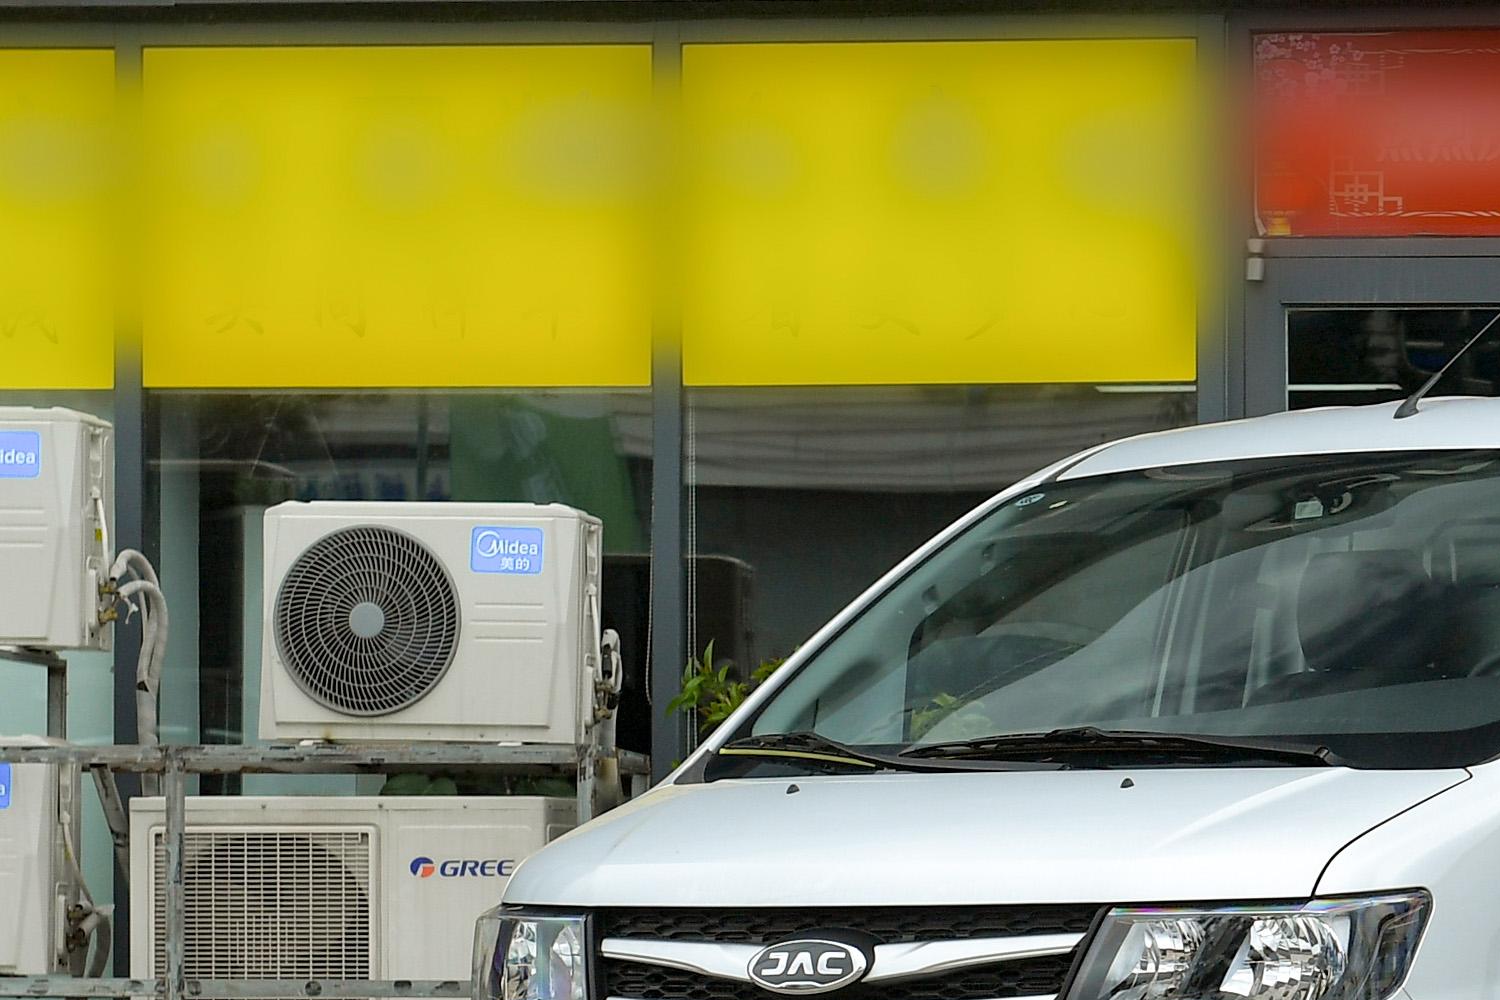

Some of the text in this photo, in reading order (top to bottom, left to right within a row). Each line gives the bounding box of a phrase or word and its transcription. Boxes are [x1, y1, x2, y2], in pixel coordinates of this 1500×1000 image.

[479, 533, 538, 556] Midea
[500, 557, 530, 571] 美的
[440, 859, 515, 878] GREE
[761, 951, 847, 976] JAC
